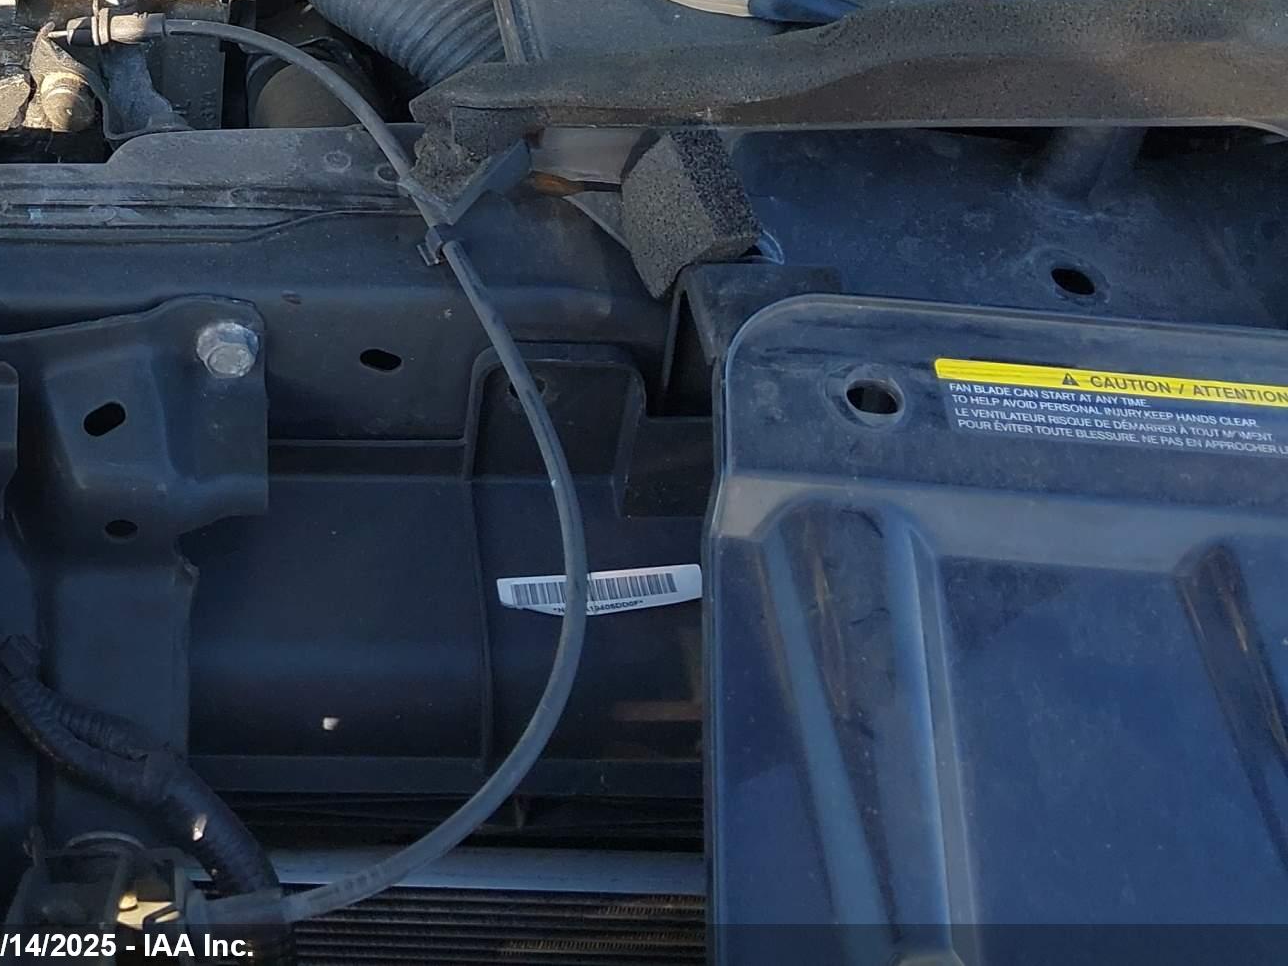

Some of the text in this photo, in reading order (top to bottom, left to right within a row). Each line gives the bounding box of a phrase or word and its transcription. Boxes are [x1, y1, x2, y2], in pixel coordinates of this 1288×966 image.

[949, 383, 1152, 408] FAN BLADE CAN START AT ANY TIME.
[1090, 376, 1172, 393] CAUTION
[951, 394, 969, 404] TO
[970, 396, 1001, 407] HELP
[1002, 398, 1038, 410] AVOID
[1040, 401, 1103, 416] PERSONAL
[1176, 413, 1218, 425] HANDS
[954, 407, 969, 417] LE
[970, 409, 1046, 424] VENTILATEUR
[1047, 415, 1093, 428] RISQUE
[1094, 418, 1111, 429] DE
[1190, 426, 1220, 437] TOUT
[957, 419, 992, 431] POUR
[993, 419, 1034, 434] ÉVITER
[1034, 425, 1074, 437] TOUTE
[1141, 435, 1159, 445] NE
[1160, 436, 1185, 447] PAS
[1185, 438, 1202, 448] EN
